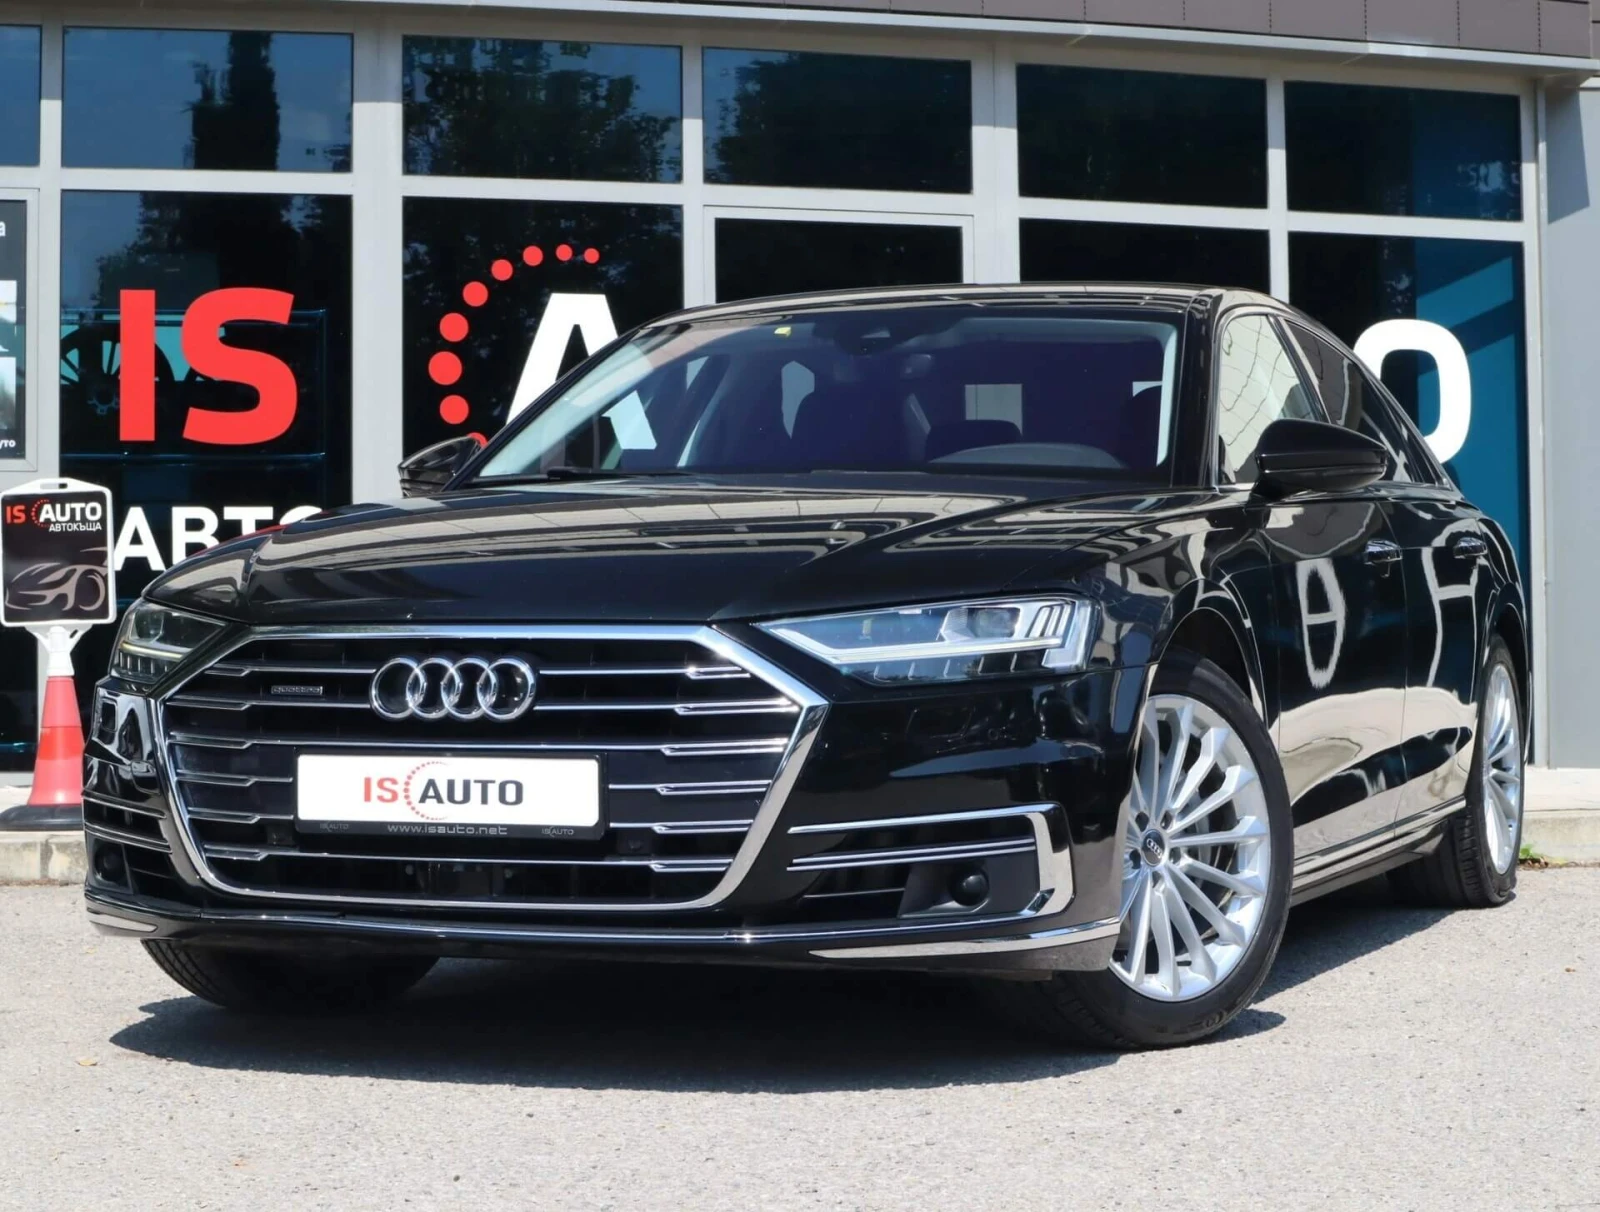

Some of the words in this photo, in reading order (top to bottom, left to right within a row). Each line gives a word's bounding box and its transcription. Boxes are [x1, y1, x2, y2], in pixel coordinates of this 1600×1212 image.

[119, 287, 298, 445] IS
[6, 504, 26, 524] IS
[39, 502, 102, 523] AUTO
[49, 523, 102, 532] АВТОКЪЩА
[363, 776, 399, 803] IS
[418, 778, 524, 806] AUTO
[387, 823, 508, 836] www.isauto.net
